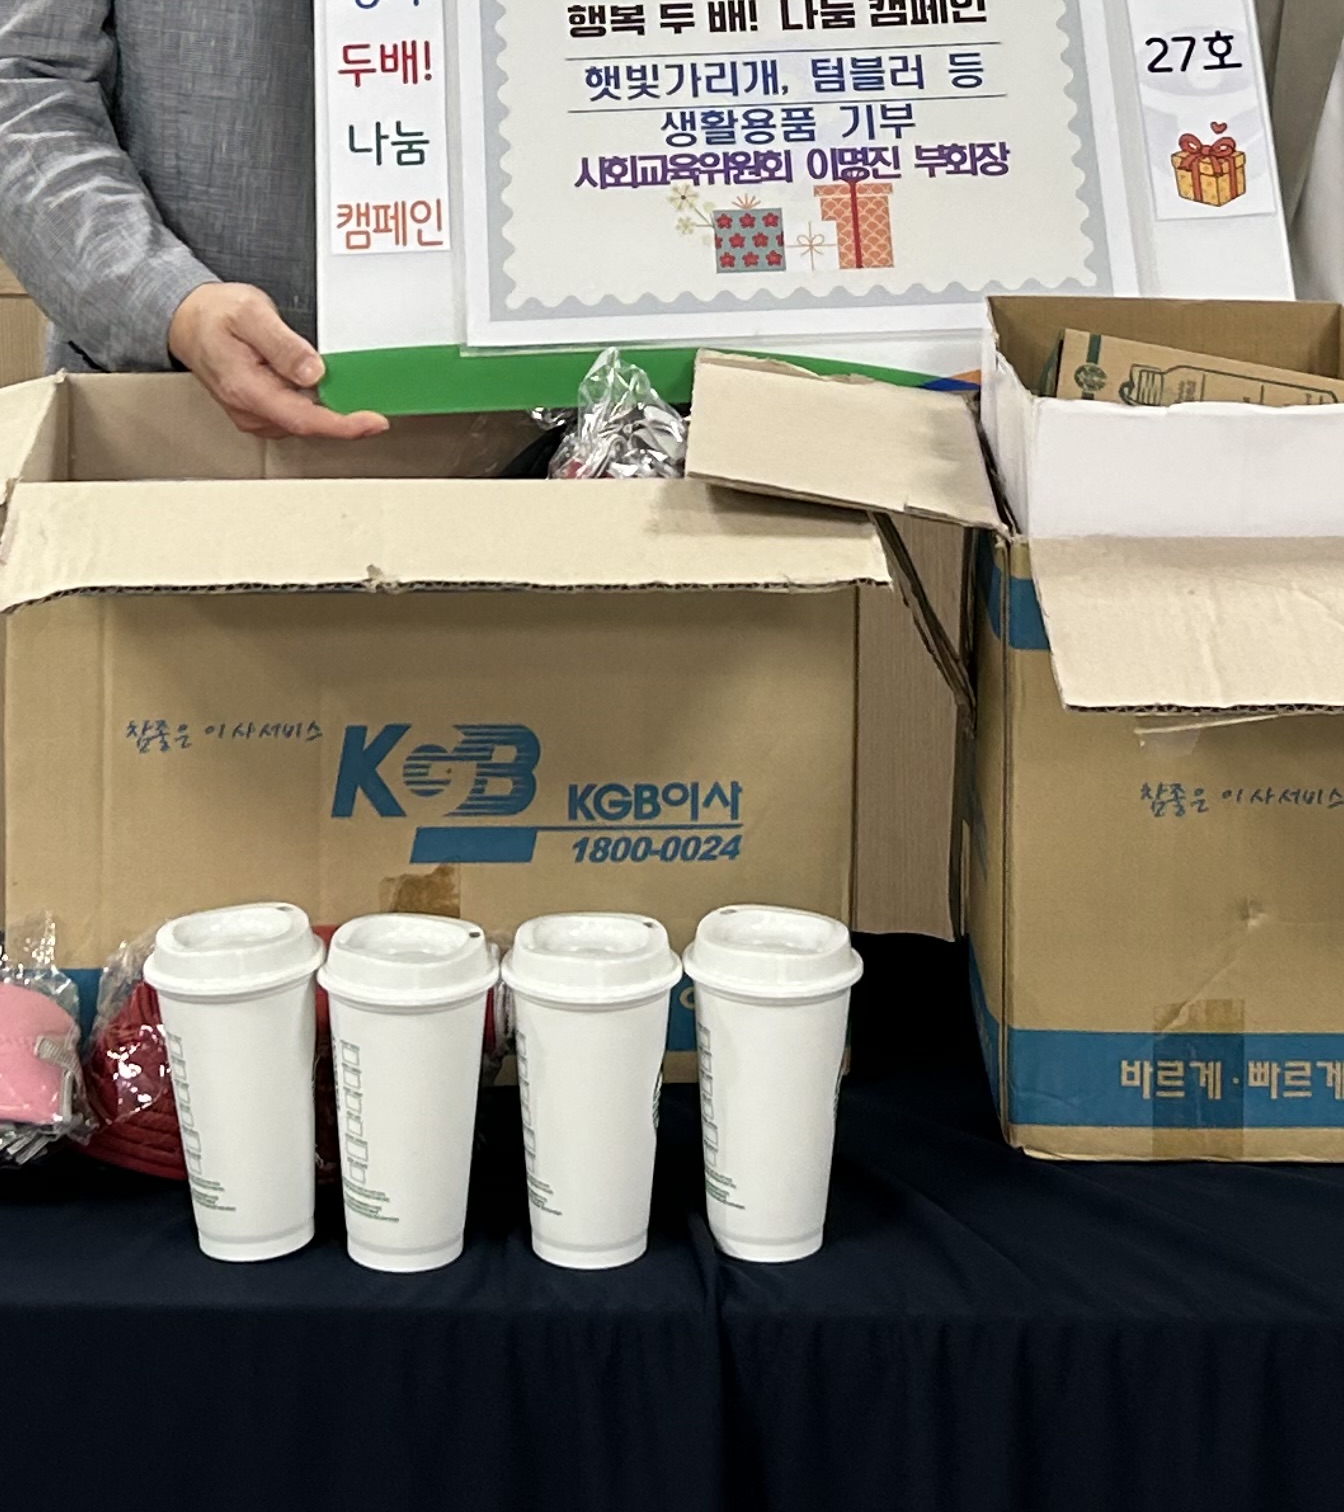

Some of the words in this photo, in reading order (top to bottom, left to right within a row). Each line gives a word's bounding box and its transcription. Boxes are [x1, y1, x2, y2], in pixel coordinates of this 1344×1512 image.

[567, 4, 646, 38] 행복
[659, 2, 696, 35] 두
[707, 0, 759, 33] 배!
[337, 39, 433, 88] 두배!
[1145, 30, 1243, 73] 27호
[584, 59, 789, 102] 햇빛가리개,
[811, 54, 925, 93] 텀블러
[948, 52, 984, 89] 등
[348, 120, 430, 166] 나눔
[660, 107, 817, 148] 생활용품
[840, 103, 916, 140] 기부
[573, 150, 793, 189] 사회교육위원회
[806, 145, 902, 182] 이명진
[913, 141, 1011, 180] 부회장
[336, 198, 444, 251] 캠페인
[567, 782, 743, 822] KGB이사
[571, 834, 742, 863] 1800-0024
[1120, 1061, 1222, 1101] 바르게
